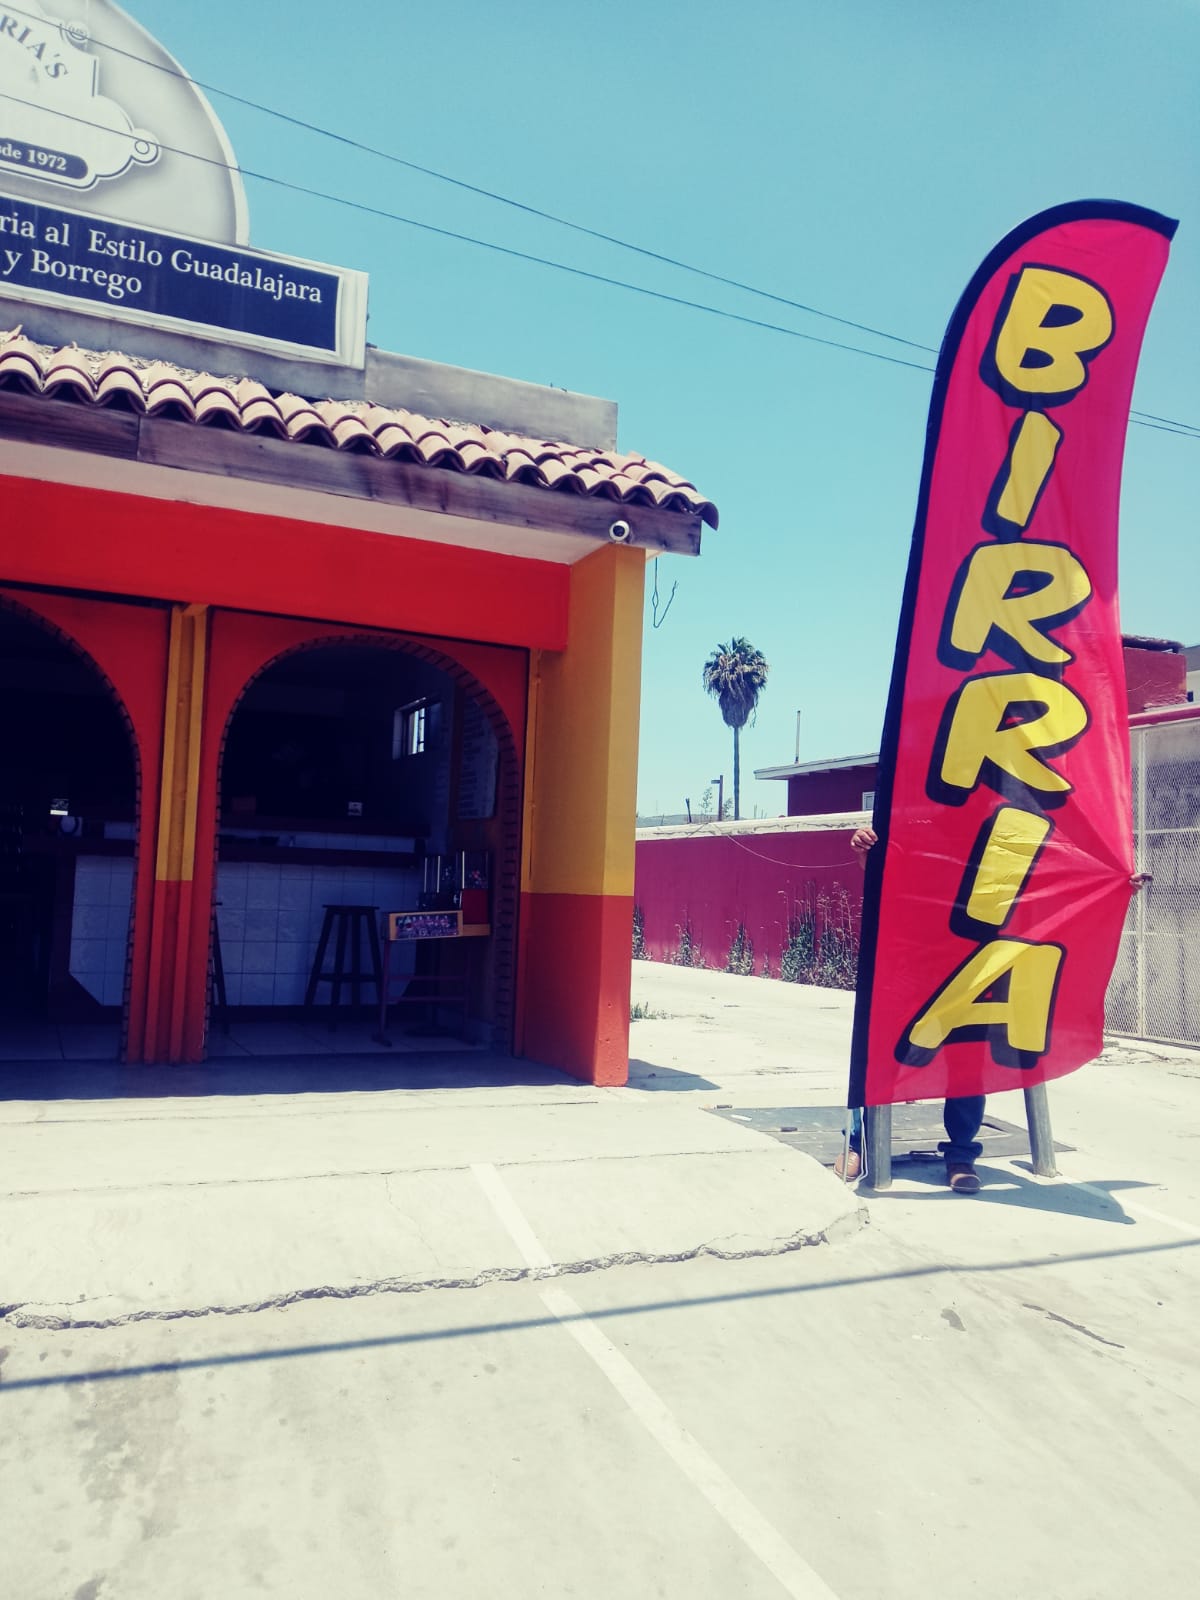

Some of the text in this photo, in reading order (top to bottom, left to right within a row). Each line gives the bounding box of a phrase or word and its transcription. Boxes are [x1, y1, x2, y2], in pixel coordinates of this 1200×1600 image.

[27, 149, 67, 171] 1972
[3, 249, 142, 299] y Borrego
[45, 223, 70, 247] al
[88, 229, 163, 266] Estilo
[171, 250, 322, 303] Guadalajara
[894, 262, 1116, 1071] BIRRIA
